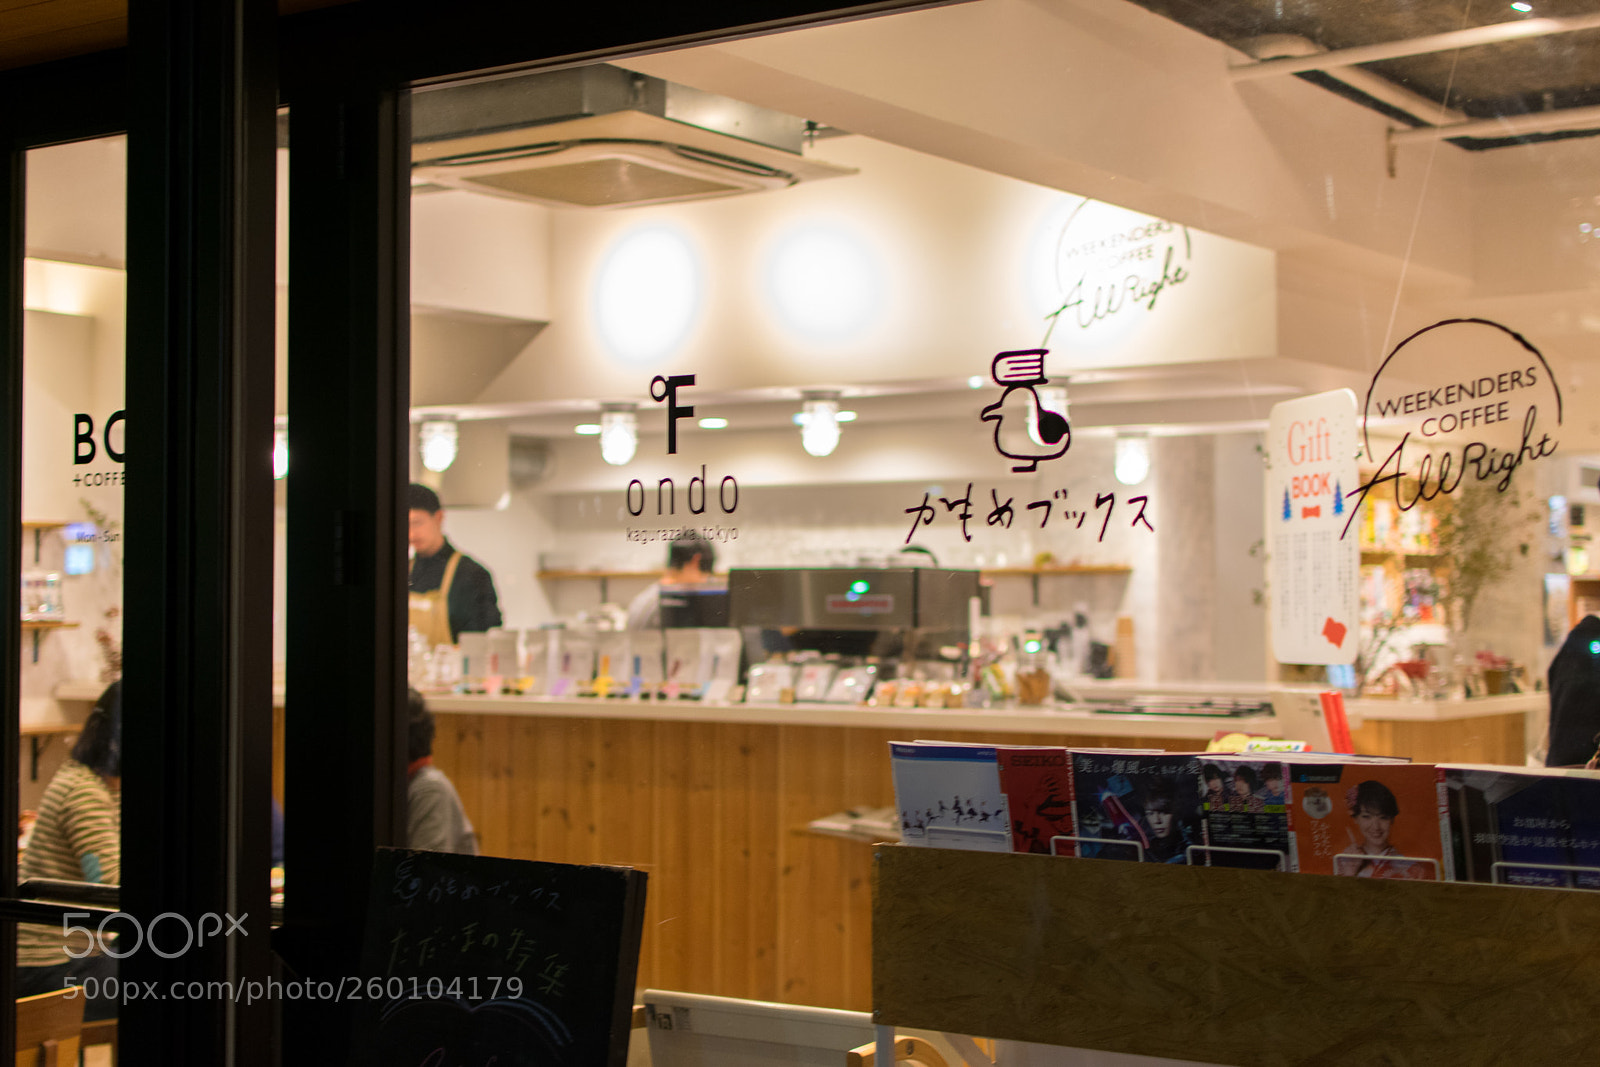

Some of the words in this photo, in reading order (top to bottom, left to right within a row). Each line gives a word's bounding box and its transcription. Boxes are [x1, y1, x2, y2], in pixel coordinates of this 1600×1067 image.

[1377, 367, 1537, 418] WEEKENDERS
[1287, 417, 1331, 466] Gift
[1421, 401, 1509, 437] COFFEE
[627, 464, 738, 516] ondo
[1292, 472, 1331, 499] BOOK
[904, 483, 1154, 544] かもめブックス
[1011, 755, 1065, 768] SEIKO
